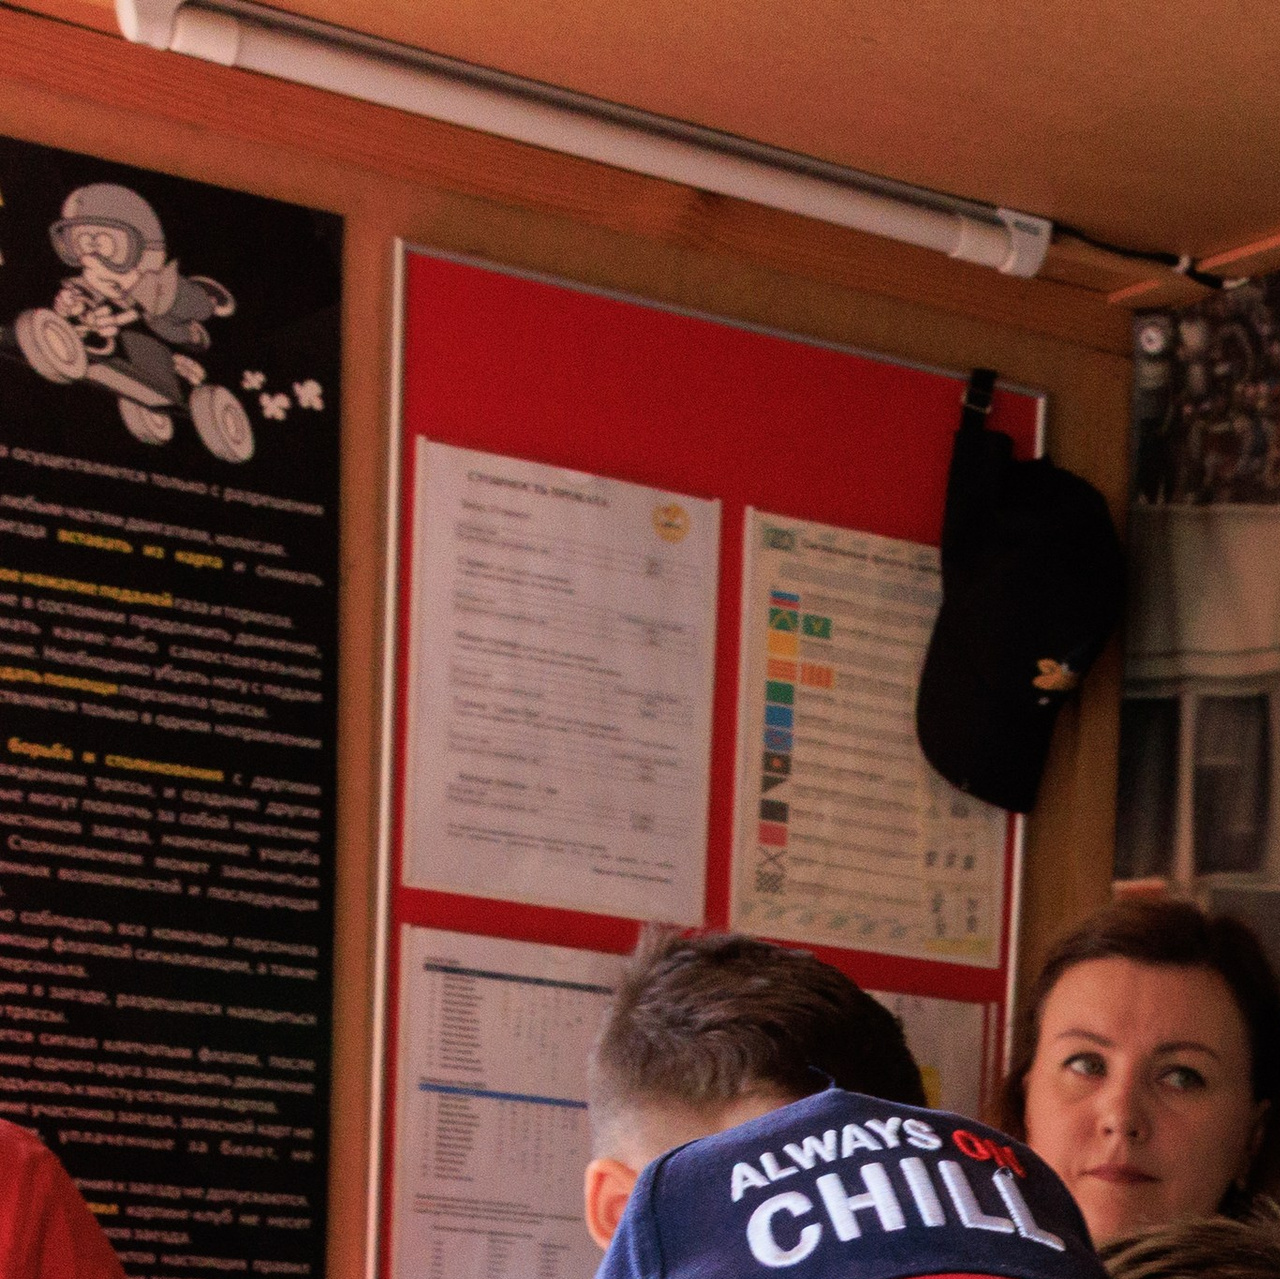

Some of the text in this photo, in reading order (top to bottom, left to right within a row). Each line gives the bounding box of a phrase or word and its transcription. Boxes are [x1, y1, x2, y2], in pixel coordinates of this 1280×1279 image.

[731, 1117, 1027, 1202] ALWAYS ON
[746, 1157, 1066, 1268] CHILL
